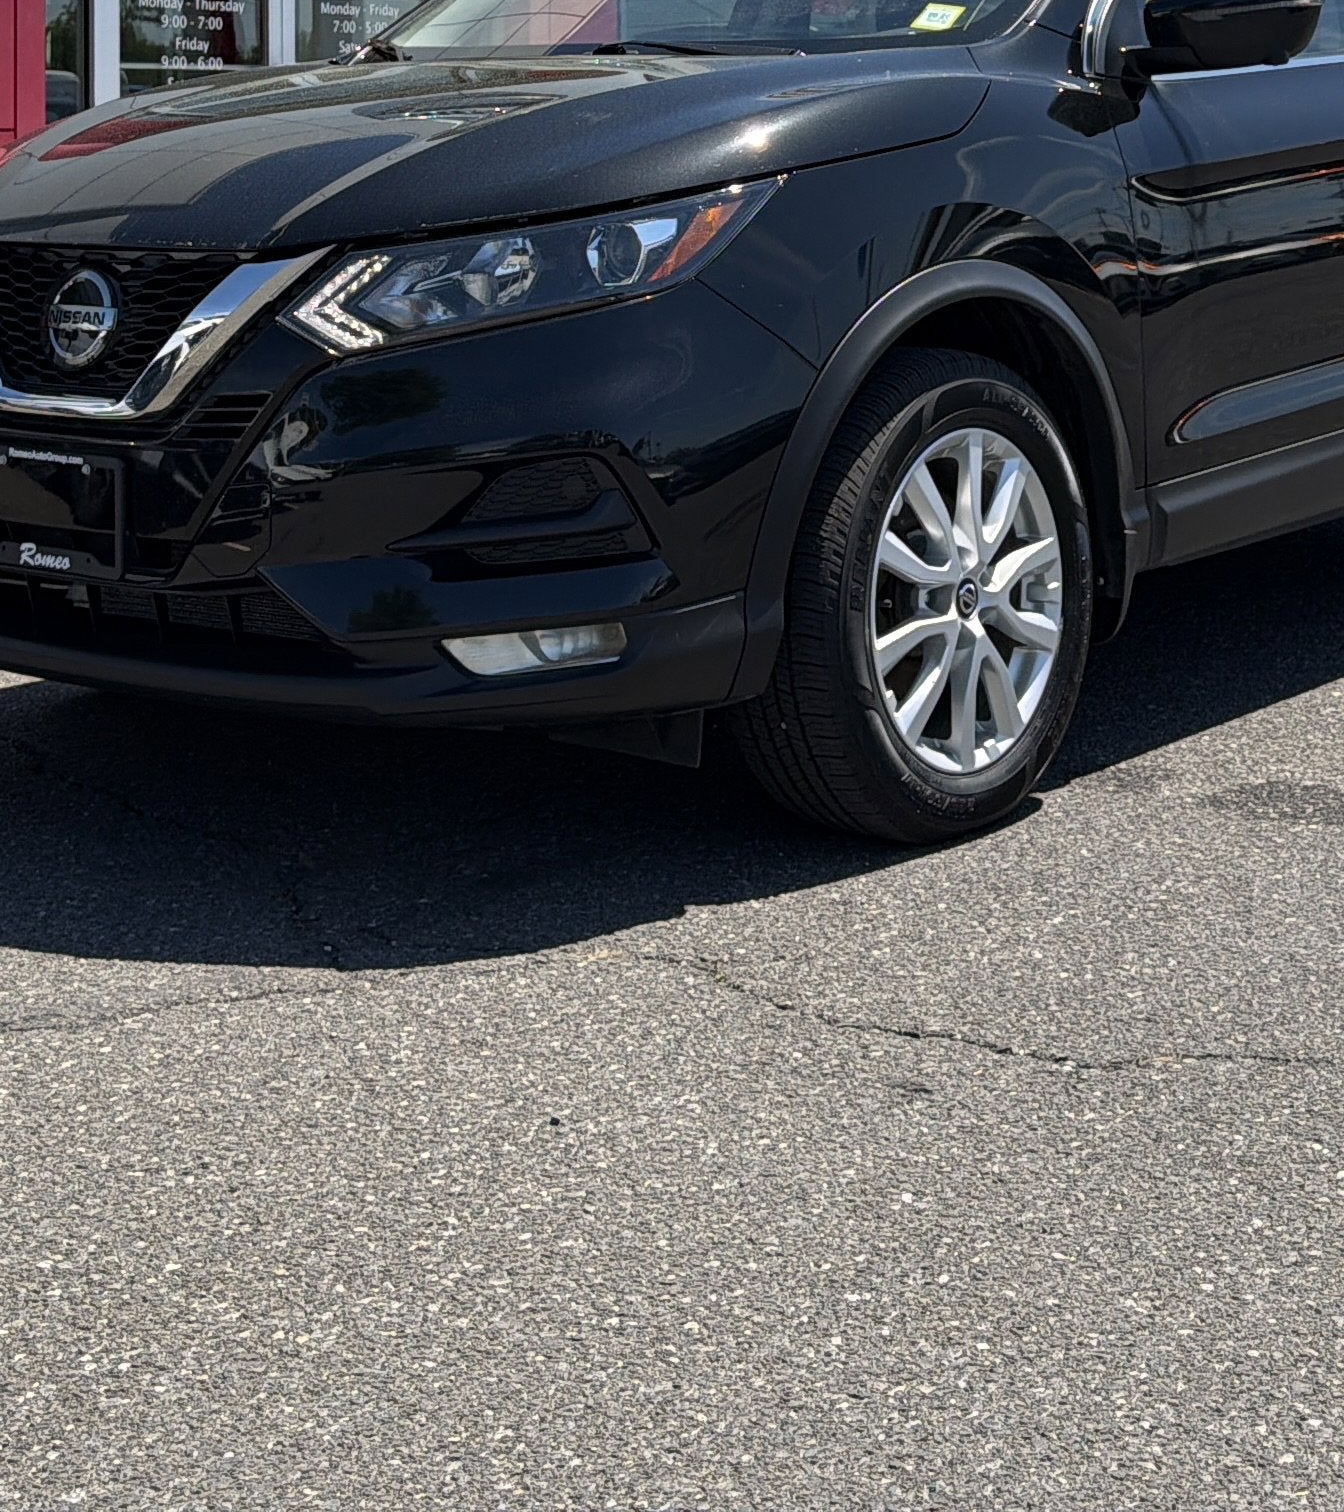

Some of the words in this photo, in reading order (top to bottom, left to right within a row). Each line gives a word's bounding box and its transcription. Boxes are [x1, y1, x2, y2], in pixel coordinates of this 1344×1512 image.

[320, 2, 361, 17] Monday
[369, 4, 400, 19] Friday
[161, 14, 187, 29] 9:00
[197, 16, 223, 30] 7:00
[333, 20, 356, 33] 7:00
[175, 37, 210, 54] Friday
[161, 55, 187, 69] 9:00
[197, 56, 223, 69] 6:00
[49, 309, 105, 326] NISSAN
[19, 541, 71, 570] Romeo
